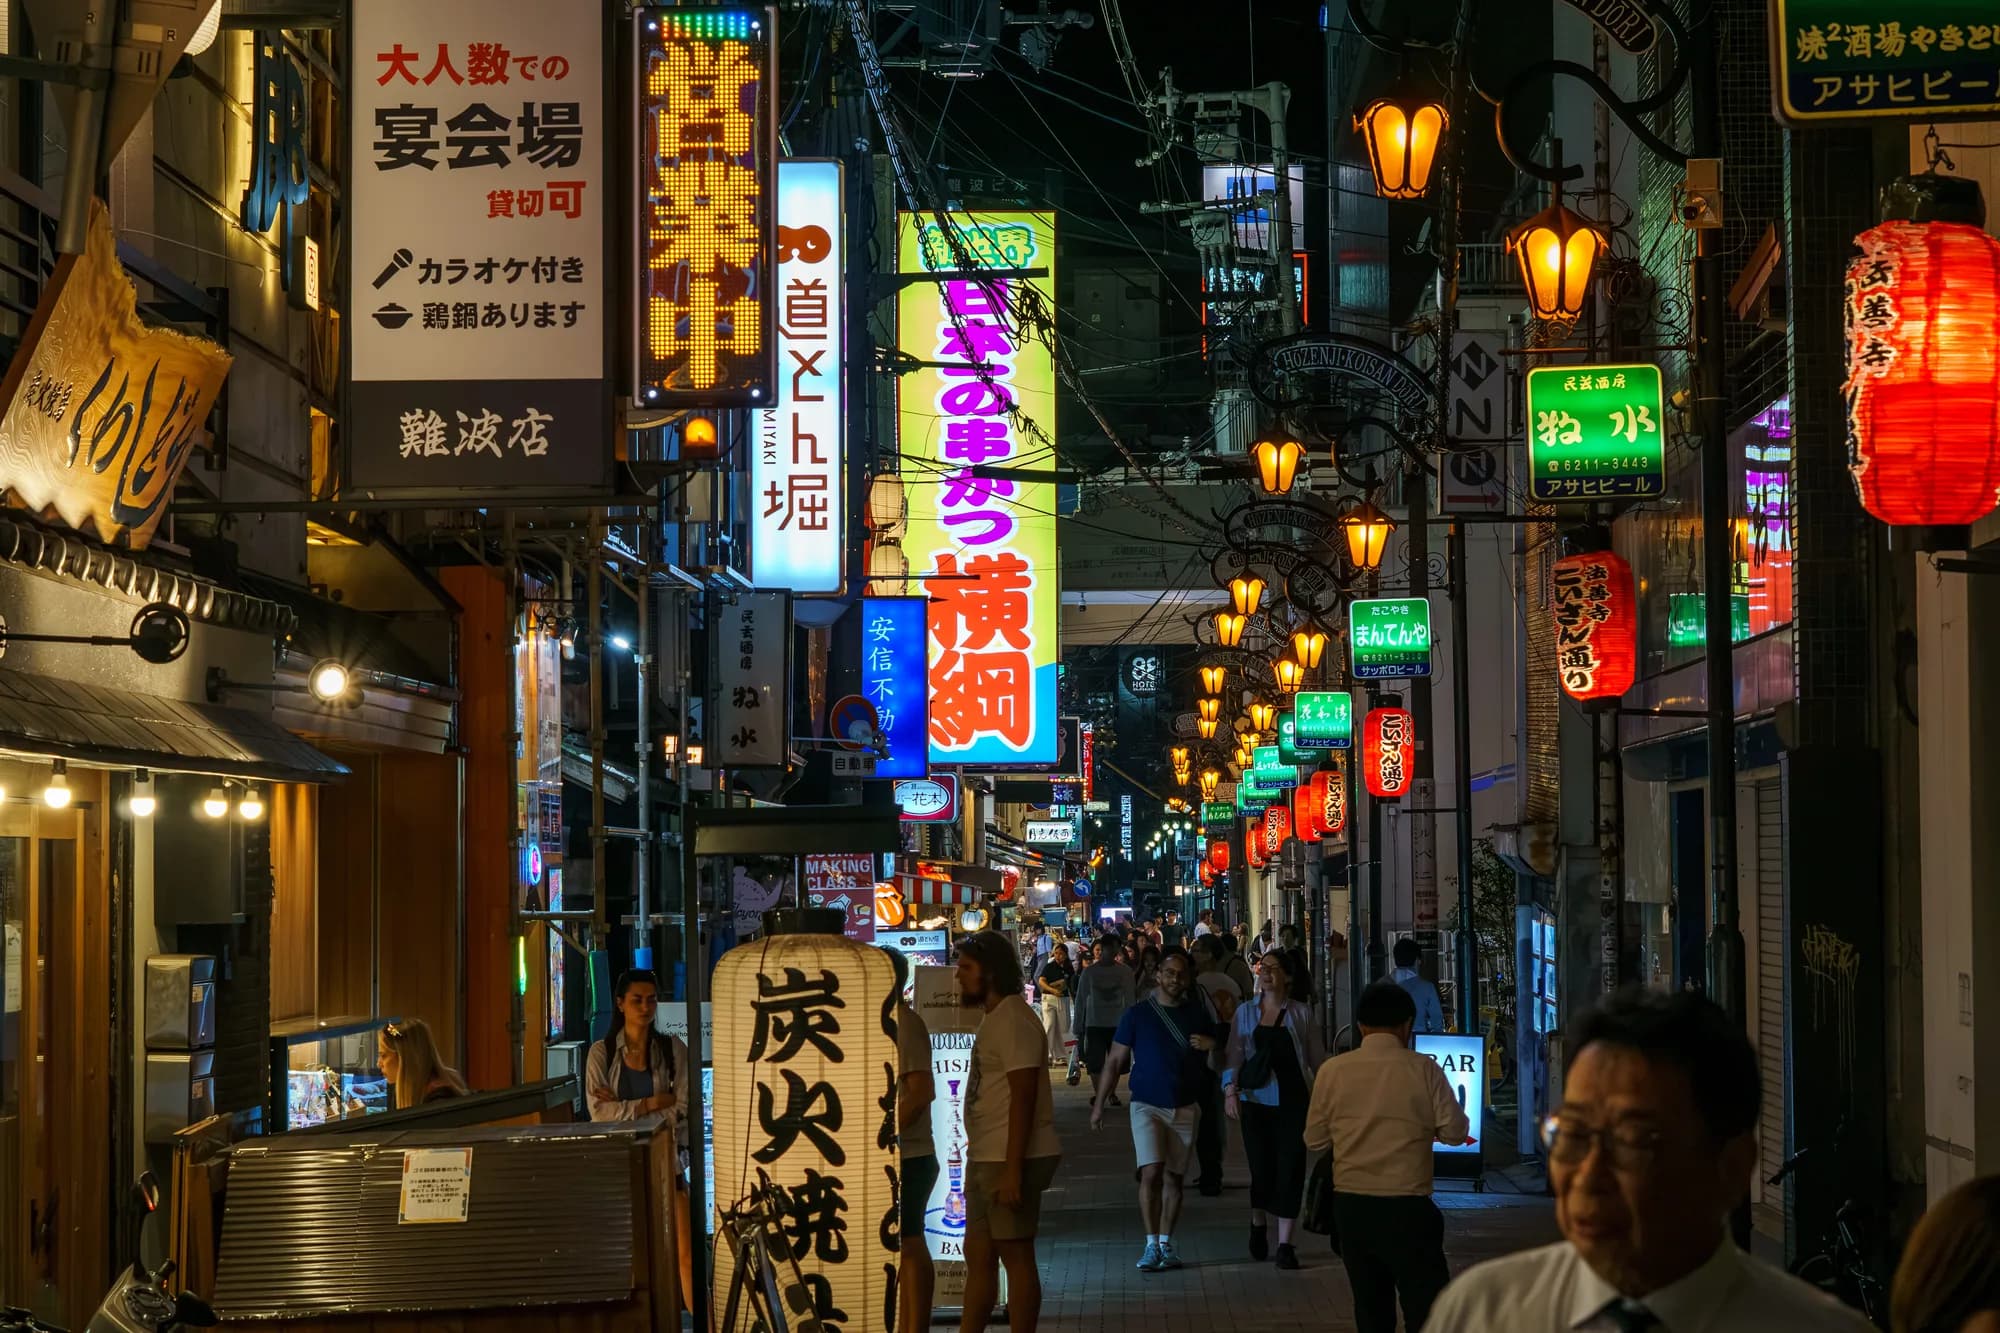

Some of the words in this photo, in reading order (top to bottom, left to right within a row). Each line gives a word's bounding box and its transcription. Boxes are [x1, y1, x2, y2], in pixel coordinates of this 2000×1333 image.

[376, 43, 570, 87] 大人数での
[1812, 70, 2000, 106] アサヒビー
[372, 102, 583, 170] 宴会場
[487, 180, 587, 219] 貸切可
[418, 256, 585, 286] カラオケ付き
[421, 301, 586, 330] 鶏鍋あります
[763, 278, 828, 531] 道とん堀
[940, 279, 1015, 546] 日本一の串かつ
[399, 408, 554, 458] 難波店
[1563, 456, 1649, 472] 6211-3443
[1546, 476, 1651, 496] アサヒビール
[1371, 605, 1409, 616] たこやき
[1553, 566, 1593, 690] こいさん通り
[923, 553, 1031, 748] 横綱
[1356, 622, 1427, 647] まんてんや
[1361, 664, 1424, 676] サッポロビール
[867, 617, 896, 762] 安信不動
[1381, 714, 1404, 791] こいさん通り
[805, 860, 870, 874] MAKING
[807, 877, 857, 889] CLASS
